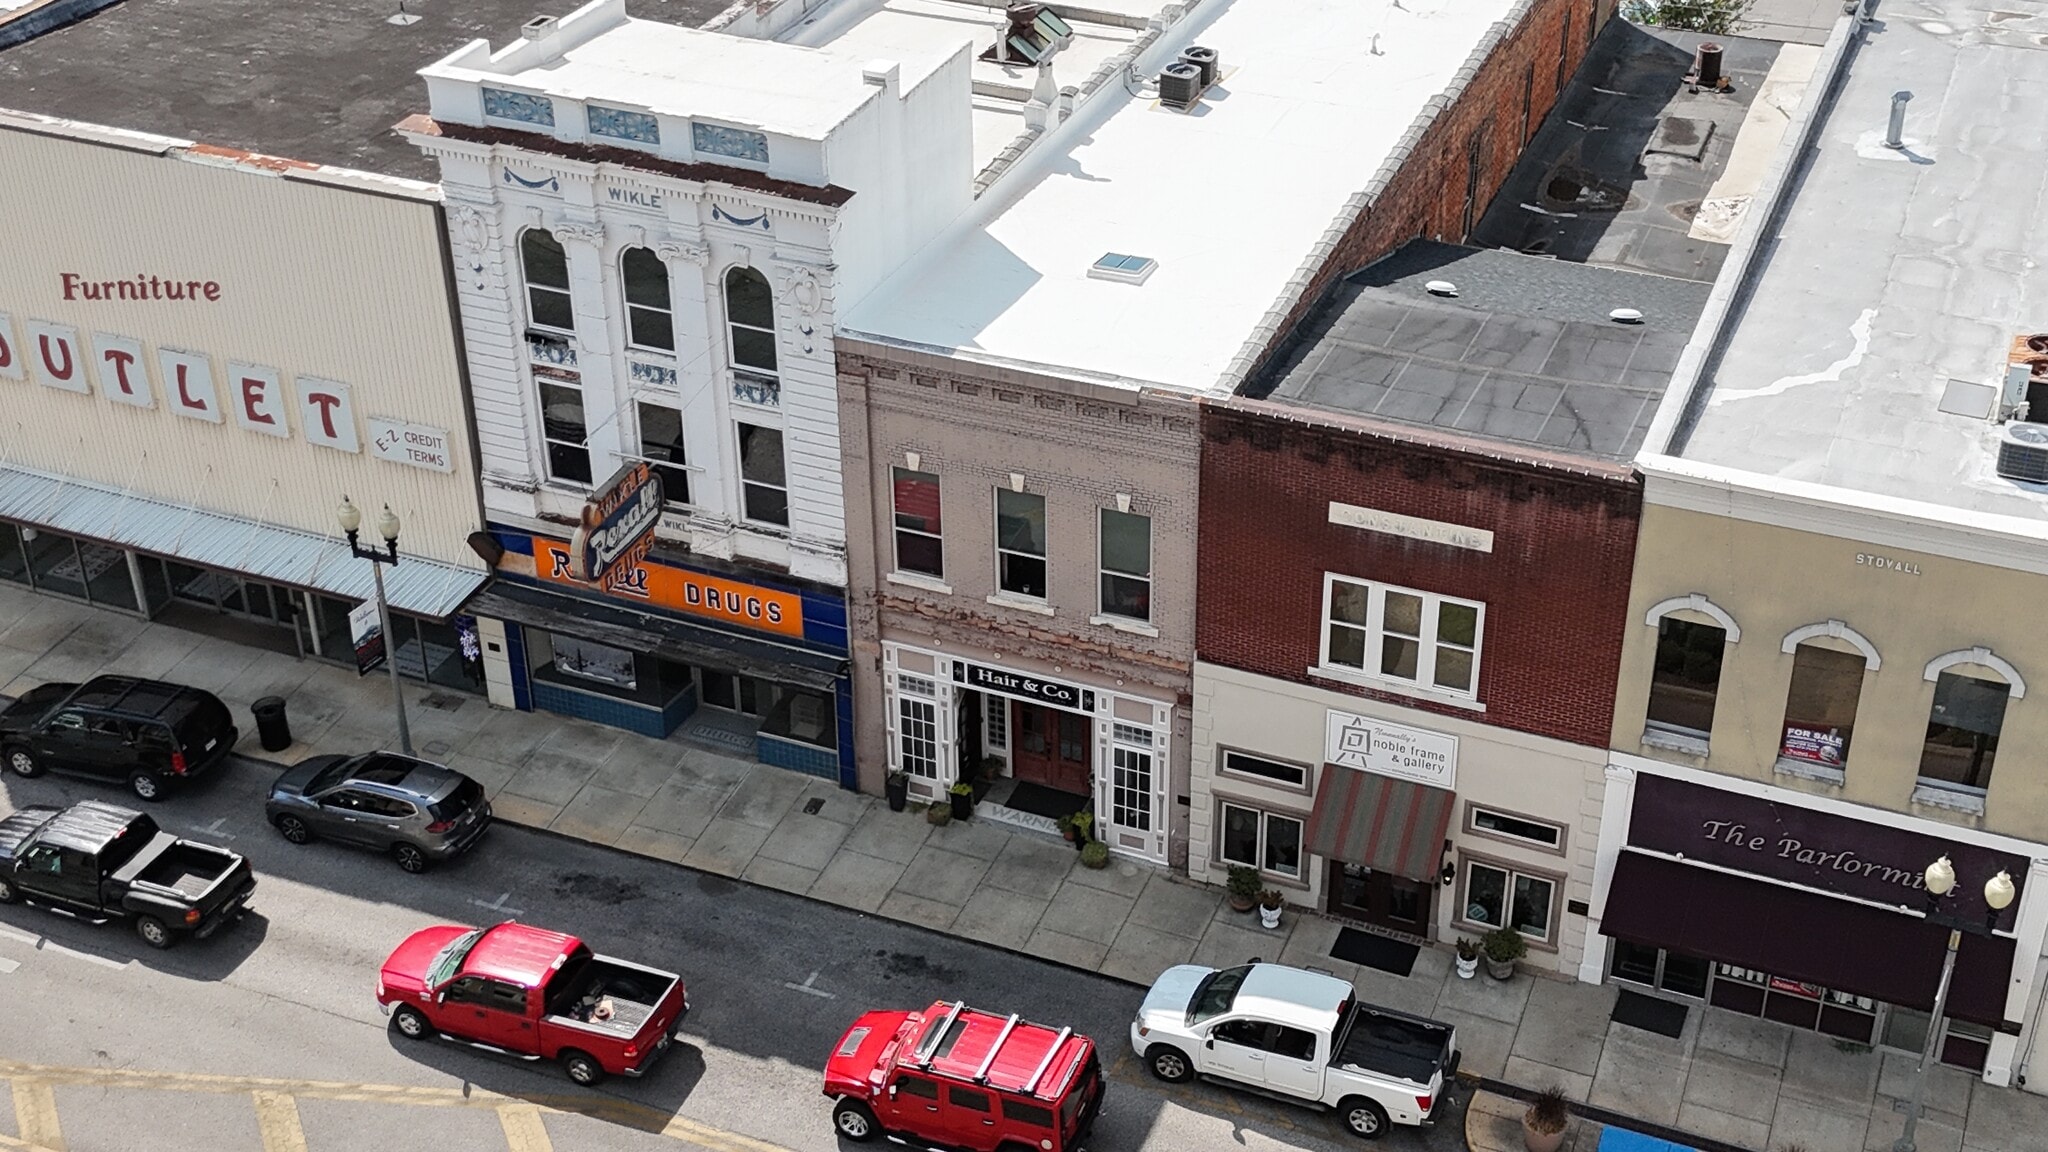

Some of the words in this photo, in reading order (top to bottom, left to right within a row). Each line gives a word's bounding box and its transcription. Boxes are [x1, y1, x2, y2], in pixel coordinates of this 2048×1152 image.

[608, 187, 662, 209] WIKLE
[60, 272, 221, 302] Furniture
[375, 429, 400, 452] E-Z
[404, 431, 443, 449] CREDIT
[406, 448, 444, 467] TERMS
[589, 479, 659, 577] Rexall
[663, 519, 692, 533] WIKL
[1342, 509, 1483, 547] CONSTANTINE
[605, 534, 655, 591] DRUGS
[1855, 553, 1922, 576] STOVALL
[548, 547, 650, 597] Rll
[684, 581, 783, 625] DRUGS
[977, 668, 1019, 688] Hair
[1023, 679, 1038, 692] &
[1042, 684, 1072, 700] Co.
[1787, 727, 1811, 738] FOR
[1813, 732, 1843, 744] SALE
[1373, 739, 1406, 753] noble
[1411, 746, 1445, 762] frame
[1391, 754, 1399, 763] &
[1404, 757, 1444, 774] gallery
[992, 806, 1059, 833] WARNE
[1703, 820, 1766, 851] The
[1777, 838, 1961, 898] Parlormit
